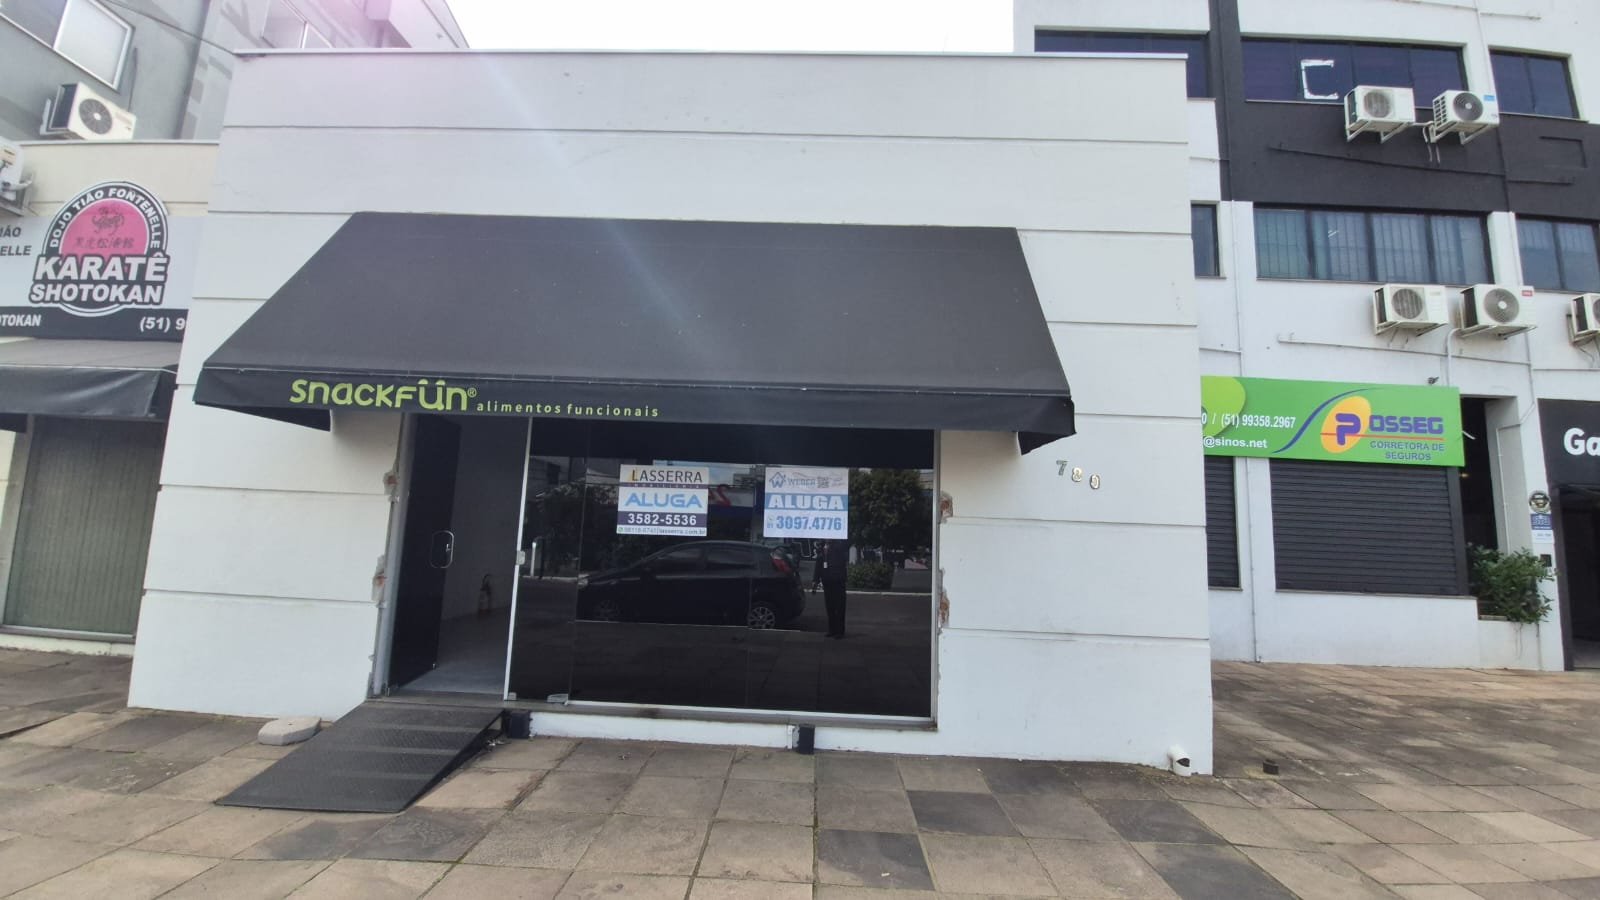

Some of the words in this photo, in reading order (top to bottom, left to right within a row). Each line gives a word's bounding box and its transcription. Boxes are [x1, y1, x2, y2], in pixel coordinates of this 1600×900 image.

[50, 211, 72, 247] DOJO
[108, 187, 161, 249] FONTENELLE
[34, 252, 168, 281] KARATÊ
[30, 283, 163, 303] SHOTOKAN
[0, 314, 41, 327] TOKAN
[139, 316, 171, 333] (51)
[476, 400, 561, 413] alimentos
[567, 403, 659, 417] funcionais
[1221, 413, 1240, 429] (51)
[1242, 414, 1296, 429] 99358.2967
[1203, 435, 1268, 449] @sinos.net
[1370, 440, 1430, 451] CORRETORA
[1432, 443, 1445, 452] DE
[1563, 427, 1600, 456] Ga
[1385, 451, 1432, 461] SEGUROS
[630, 468, 703, 483] LASSERRA
[624, 492, 703, 508] ALUGA
[768, 494, 844, 511] ALUGA
[627, 512, 697, 525] 3582-5536
[776, 515, 842, 531] 3097.4776
